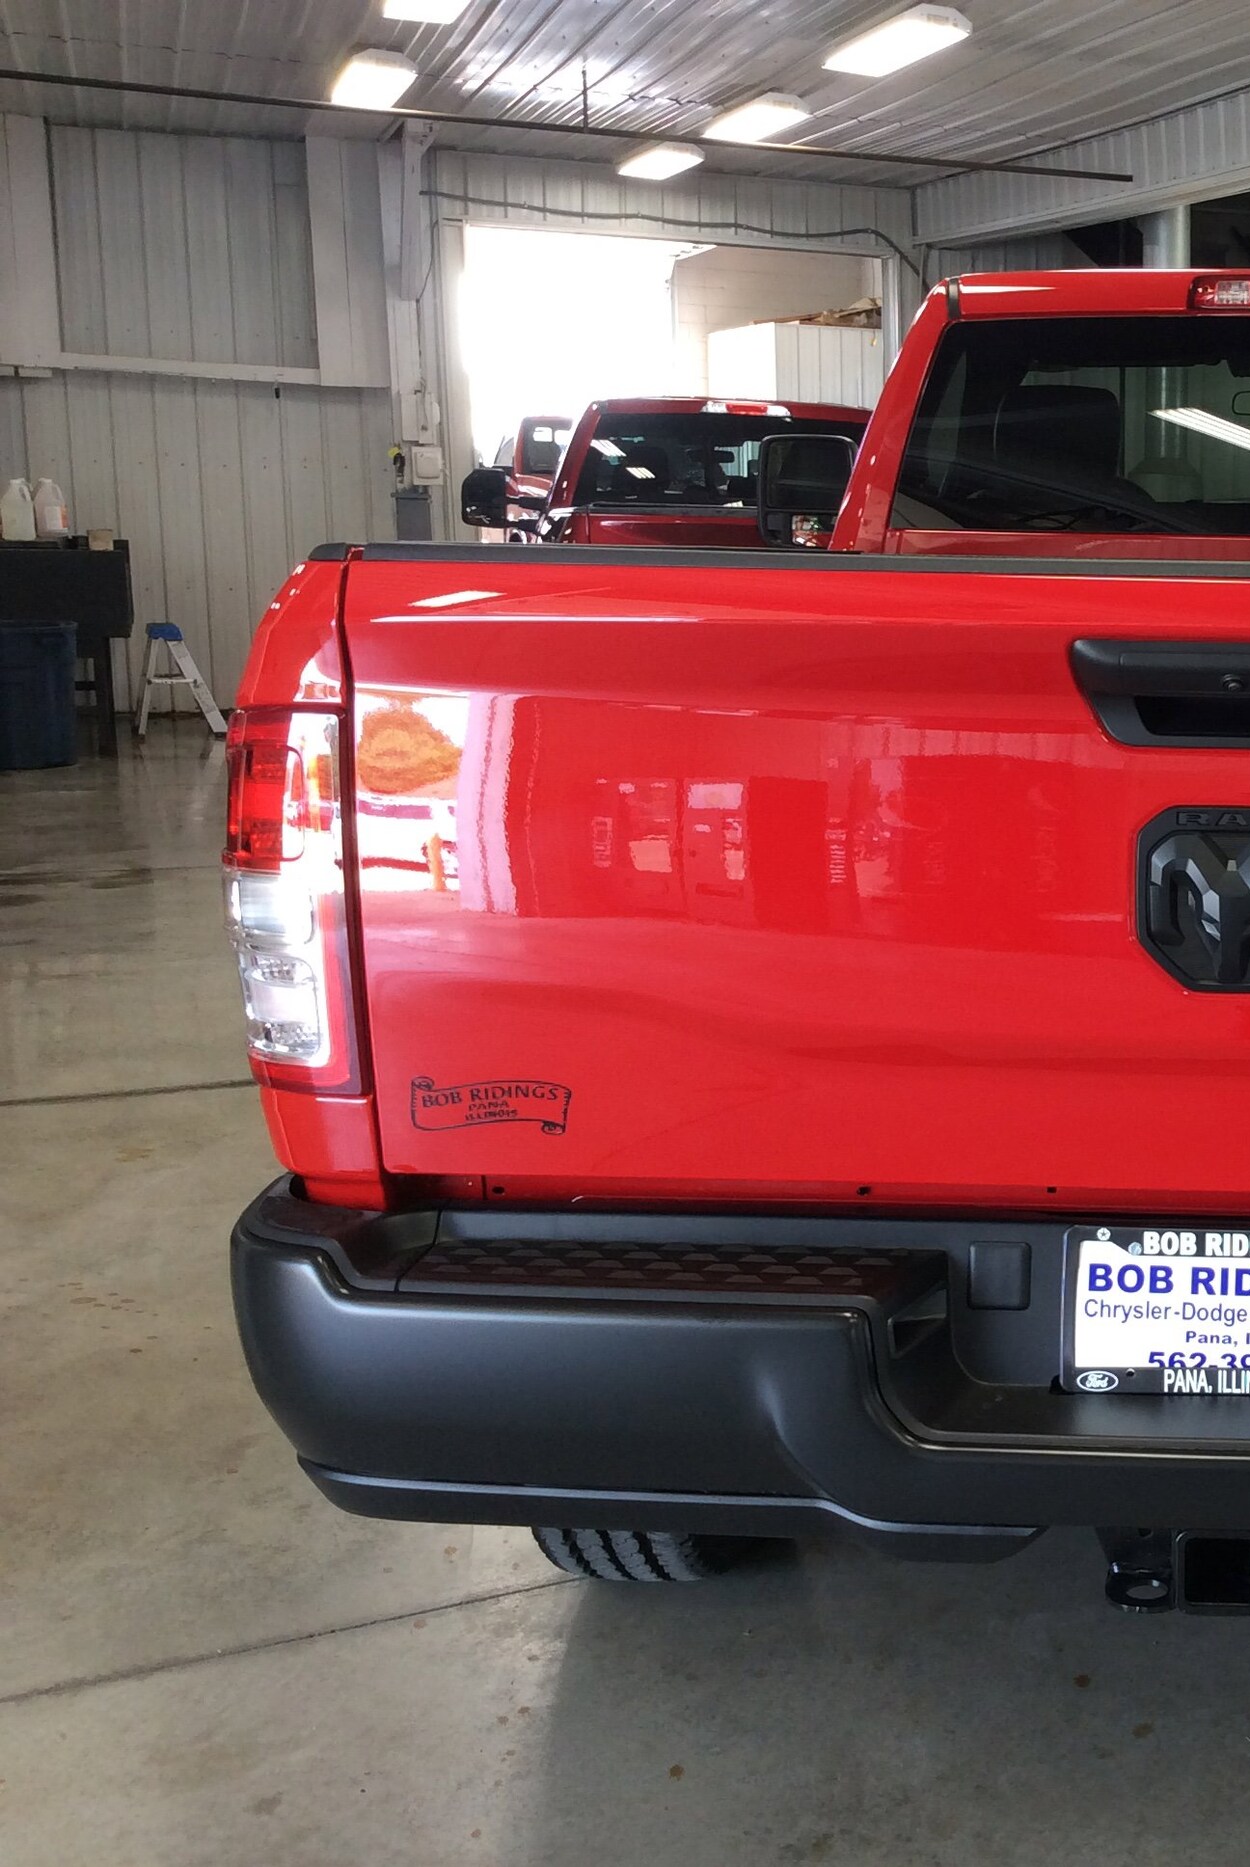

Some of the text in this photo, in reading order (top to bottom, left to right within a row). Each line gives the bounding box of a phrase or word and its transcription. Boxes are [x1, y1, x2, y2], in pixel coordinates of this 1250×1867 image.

[421, 1085, 558, 1107] BOB RIDINGS
[1143, 1231, 1197, 1255] BOB
[1088, 1263, 1174, 1293] BOB
[1185, 1331, 1238, 1347] Pana,
[1163, 1369, 1213, 1393] PANA,
